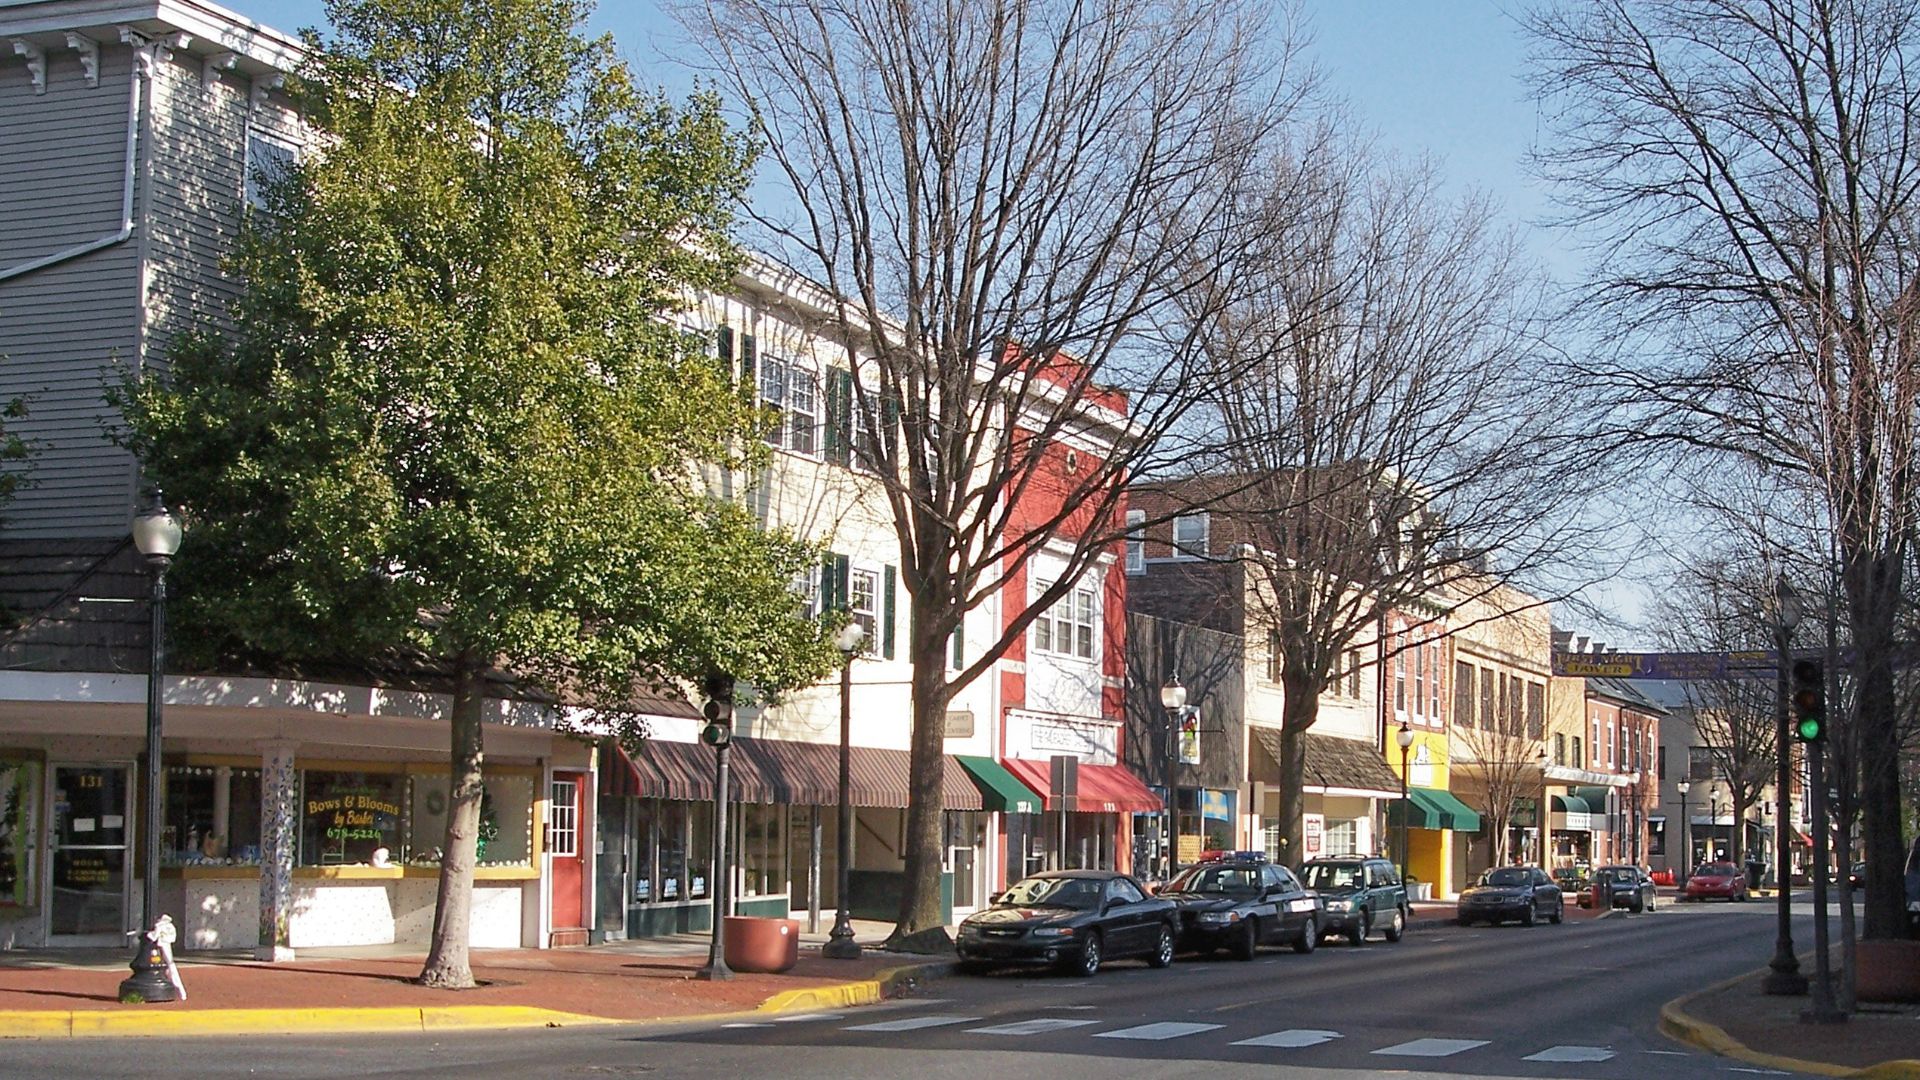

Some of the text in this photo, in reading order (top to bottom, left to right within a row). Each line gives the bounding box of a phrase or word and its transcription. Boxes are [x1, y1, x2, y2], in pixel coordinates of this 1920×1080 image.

[80, 775, 104, 788] 131
[308, 795, 400, 816] Bows & Blooms
[334, 811, 345, 827] by
[326, 827, 381, 840] 678-5226
